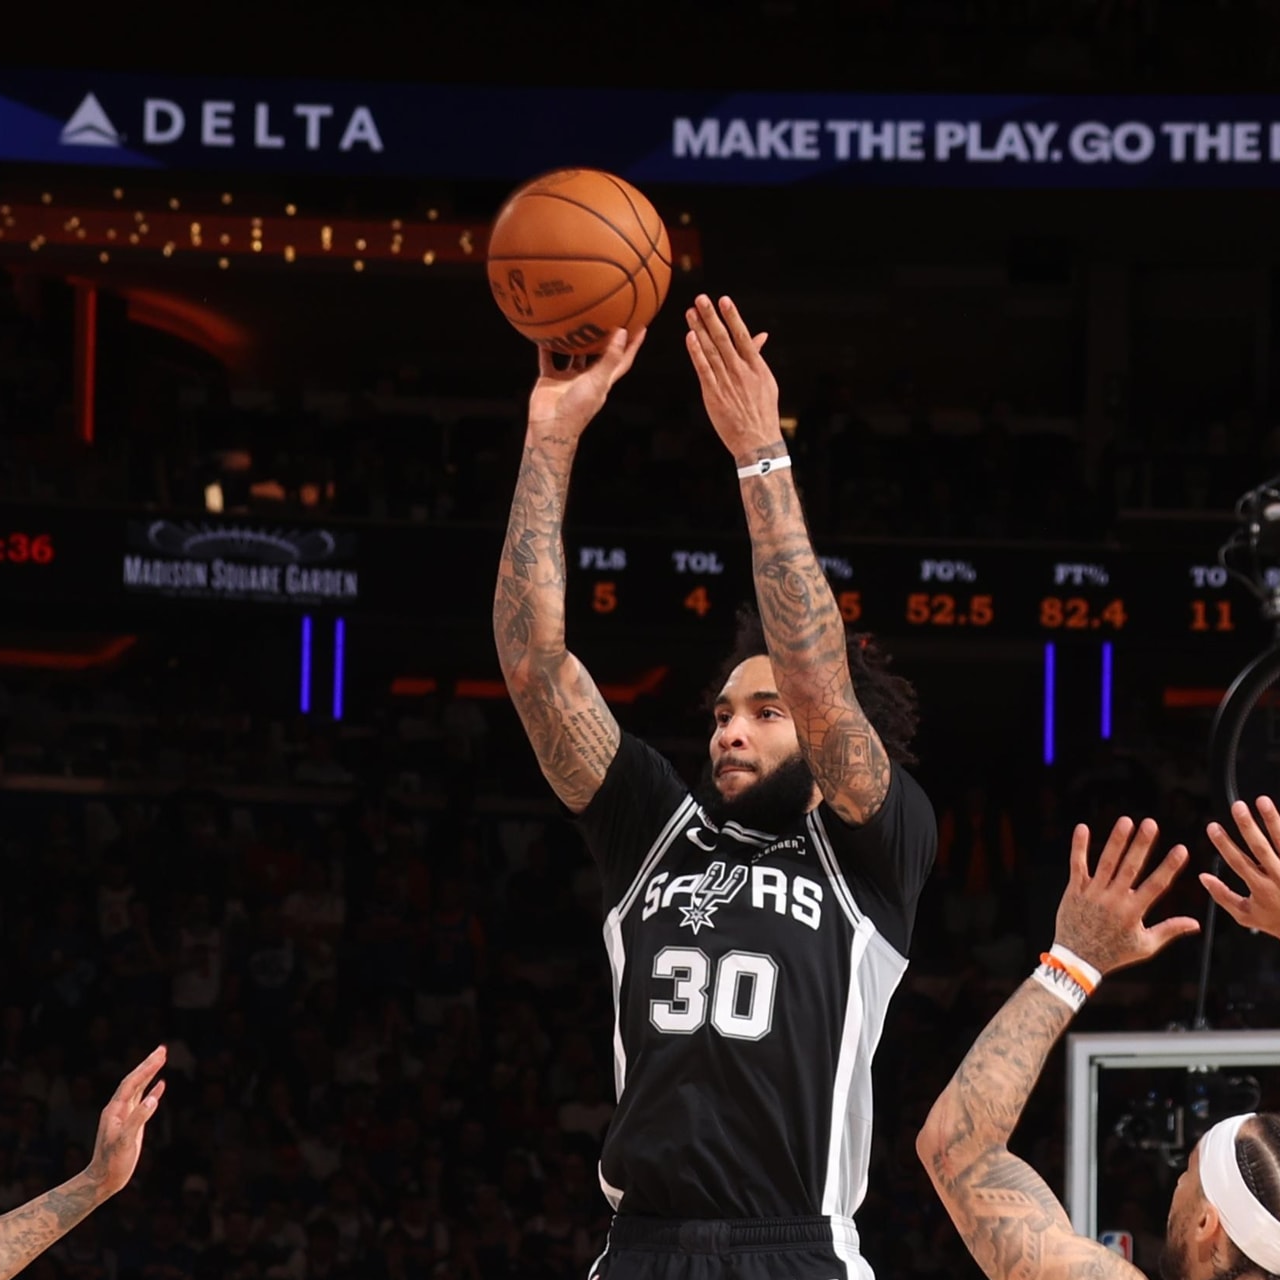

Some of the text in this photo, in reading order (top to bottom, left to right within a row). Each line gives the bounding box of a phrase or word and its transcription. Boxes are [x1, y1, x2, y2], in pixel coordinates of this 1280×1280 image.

[143, 99, 385, 152] DELTA
[673, 118, 822, 160] MAKE
[826, 120, 926, 162] THE
[935, 121, 1062, 164] PLAY.
[1069, 121, 1156, 165] GO
[1161, 122, 1262, 164] THE
[123, 554, 209, 588] MADISON
[210, 558, 282, 594] SQUARE
[285, 563, 360, 598] GARDEN
[673, 551, 724, 576] TOL
[920, 560, 978, 583] FG%
[1054, 563, 1111, 587] FT%
[1190, 566, 1228, 588] TO
[593, 581, 620, 615] 5
[684, 586, 712, 618] 4
[906, 593, 996, 628] 52.5
[1040, 597, 1129, 631] 82.4
[1190, 600, 1235, 633] 11
[641, 861, 824, 935] SPURS
[649, 946, 779, 1041] 30
